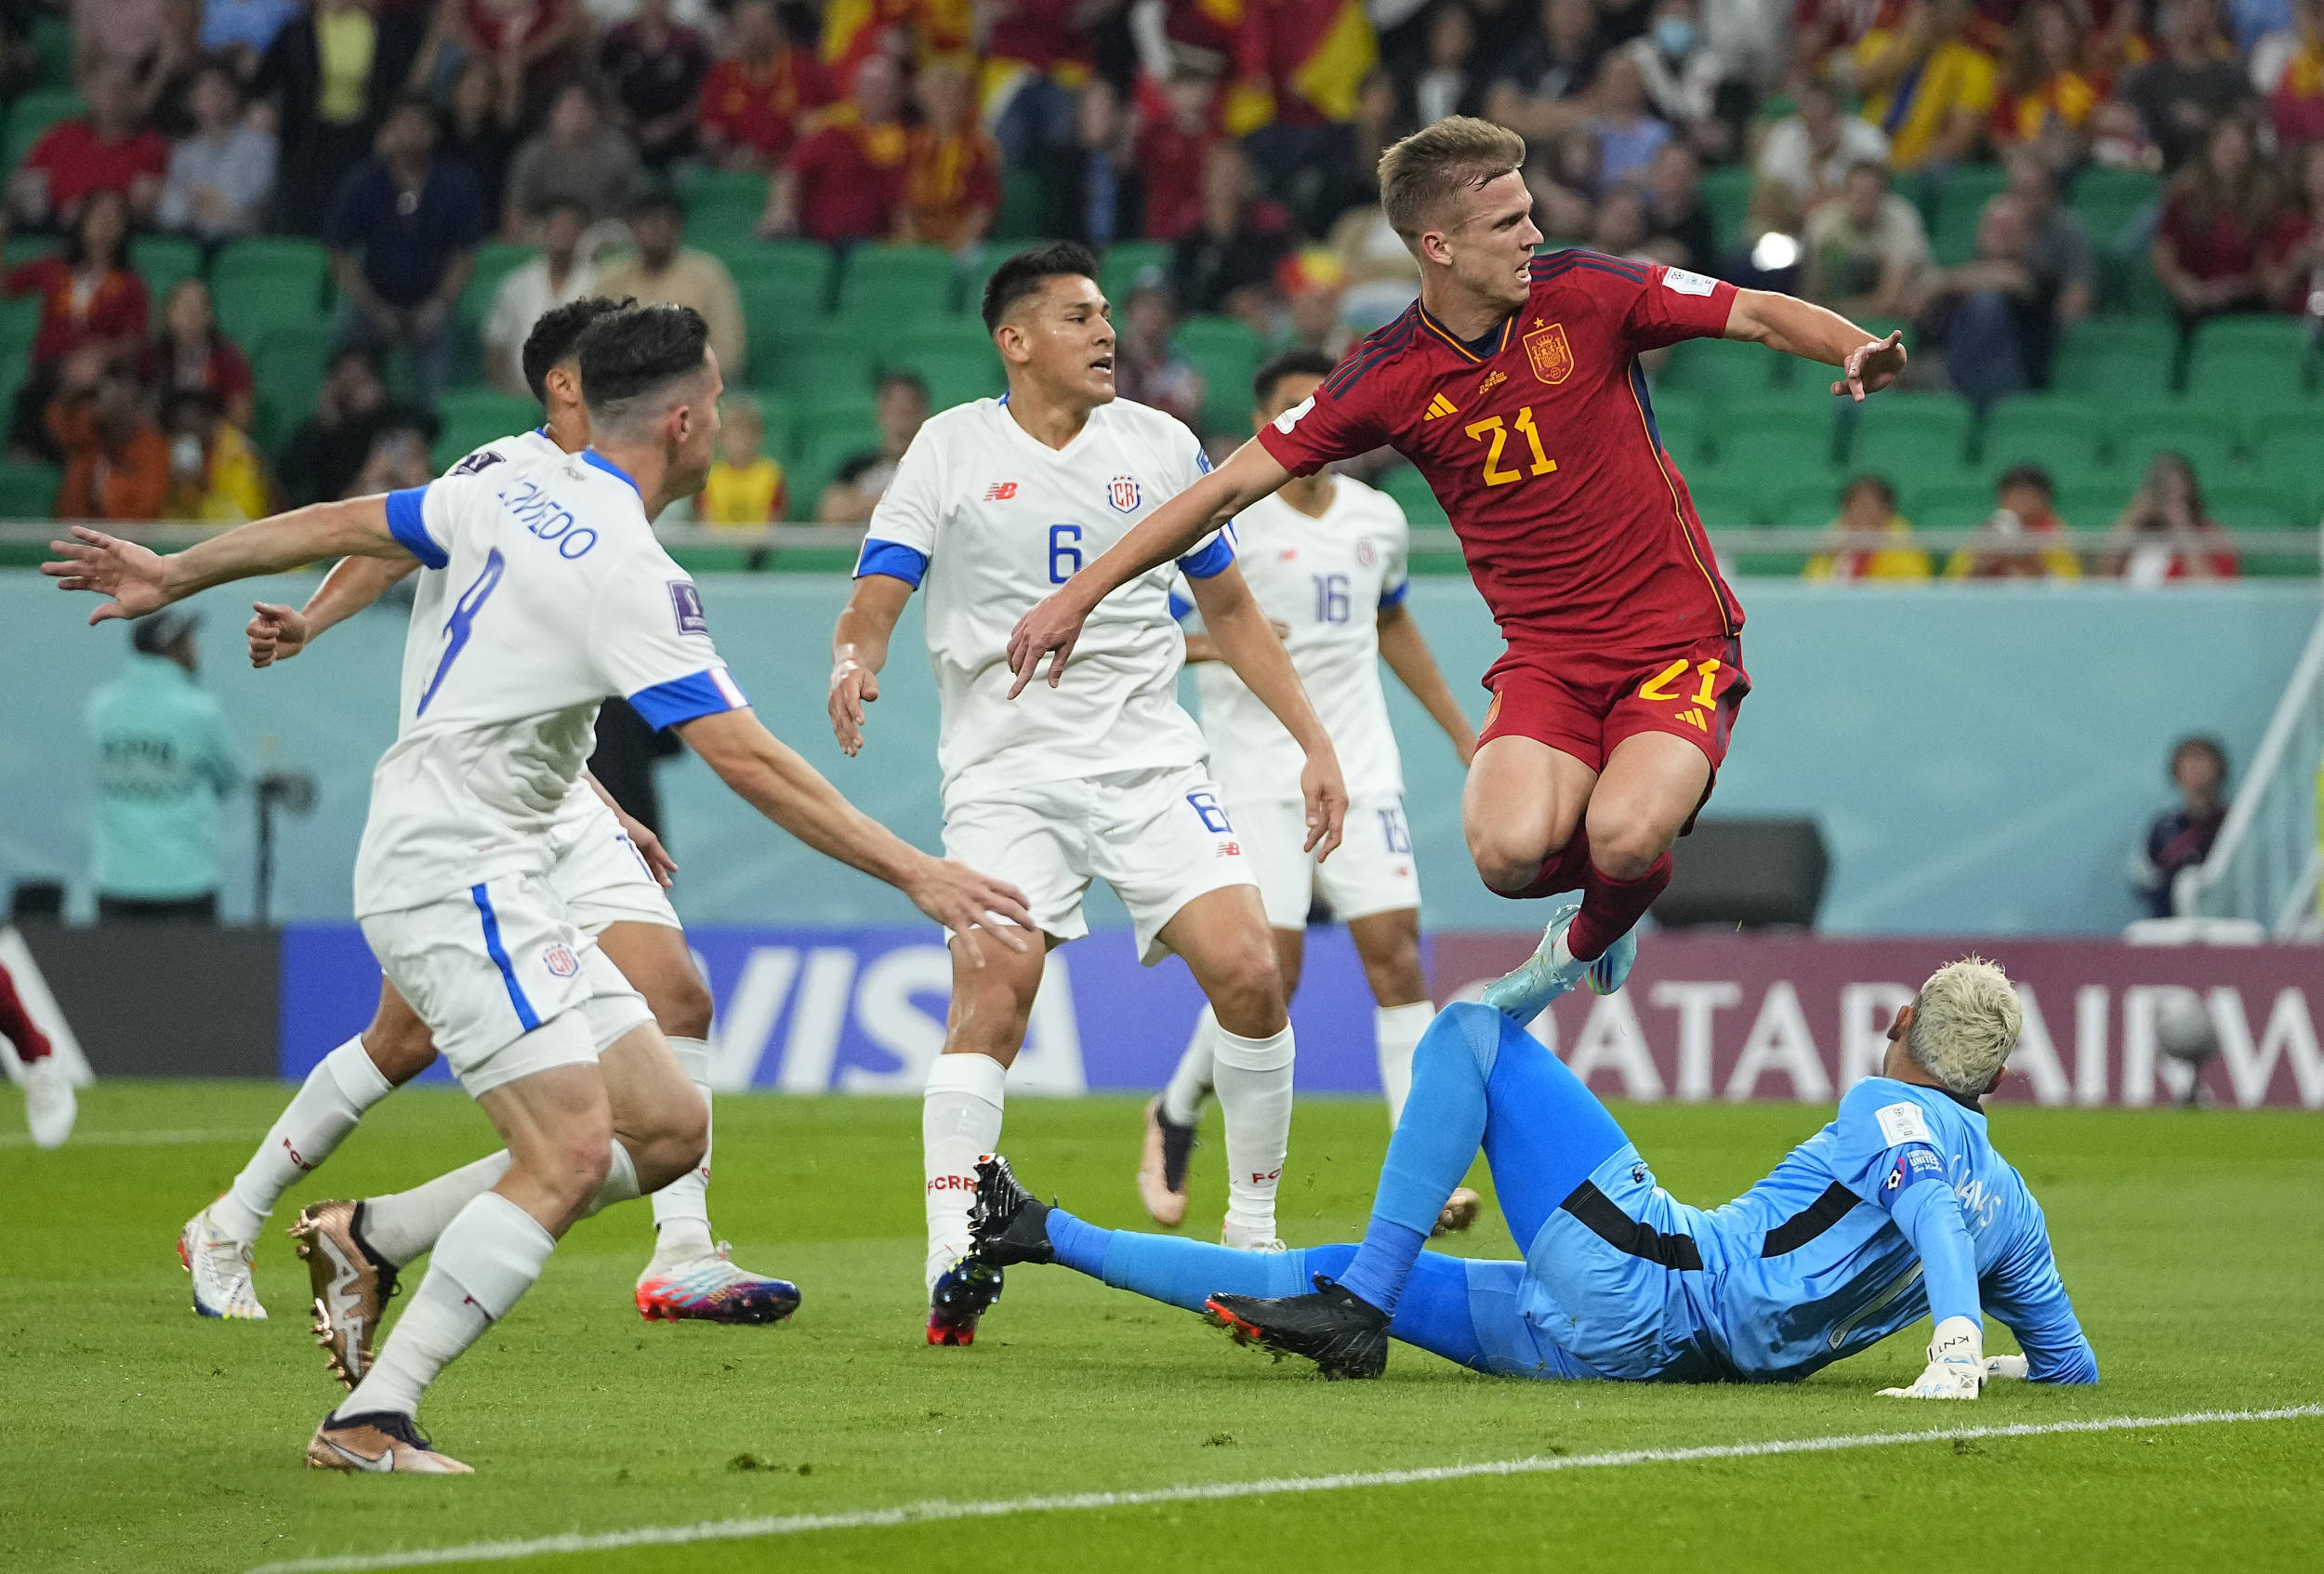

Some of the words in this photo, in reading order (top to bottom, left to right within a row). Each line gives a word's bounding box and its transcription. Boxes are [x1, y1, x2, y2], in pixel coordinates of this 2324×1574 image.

[1465, 406, 1558, 486] 21
[1115, 483, 1135, 507] CR
[1049, 523, 1082, 584] 6
[1312, 574, 1349, 623] 16
[1639, 658, 1720, 711] 21
[1186, 793, 1234, 834] 6
[690, 945, 1087, 1094] VISA
